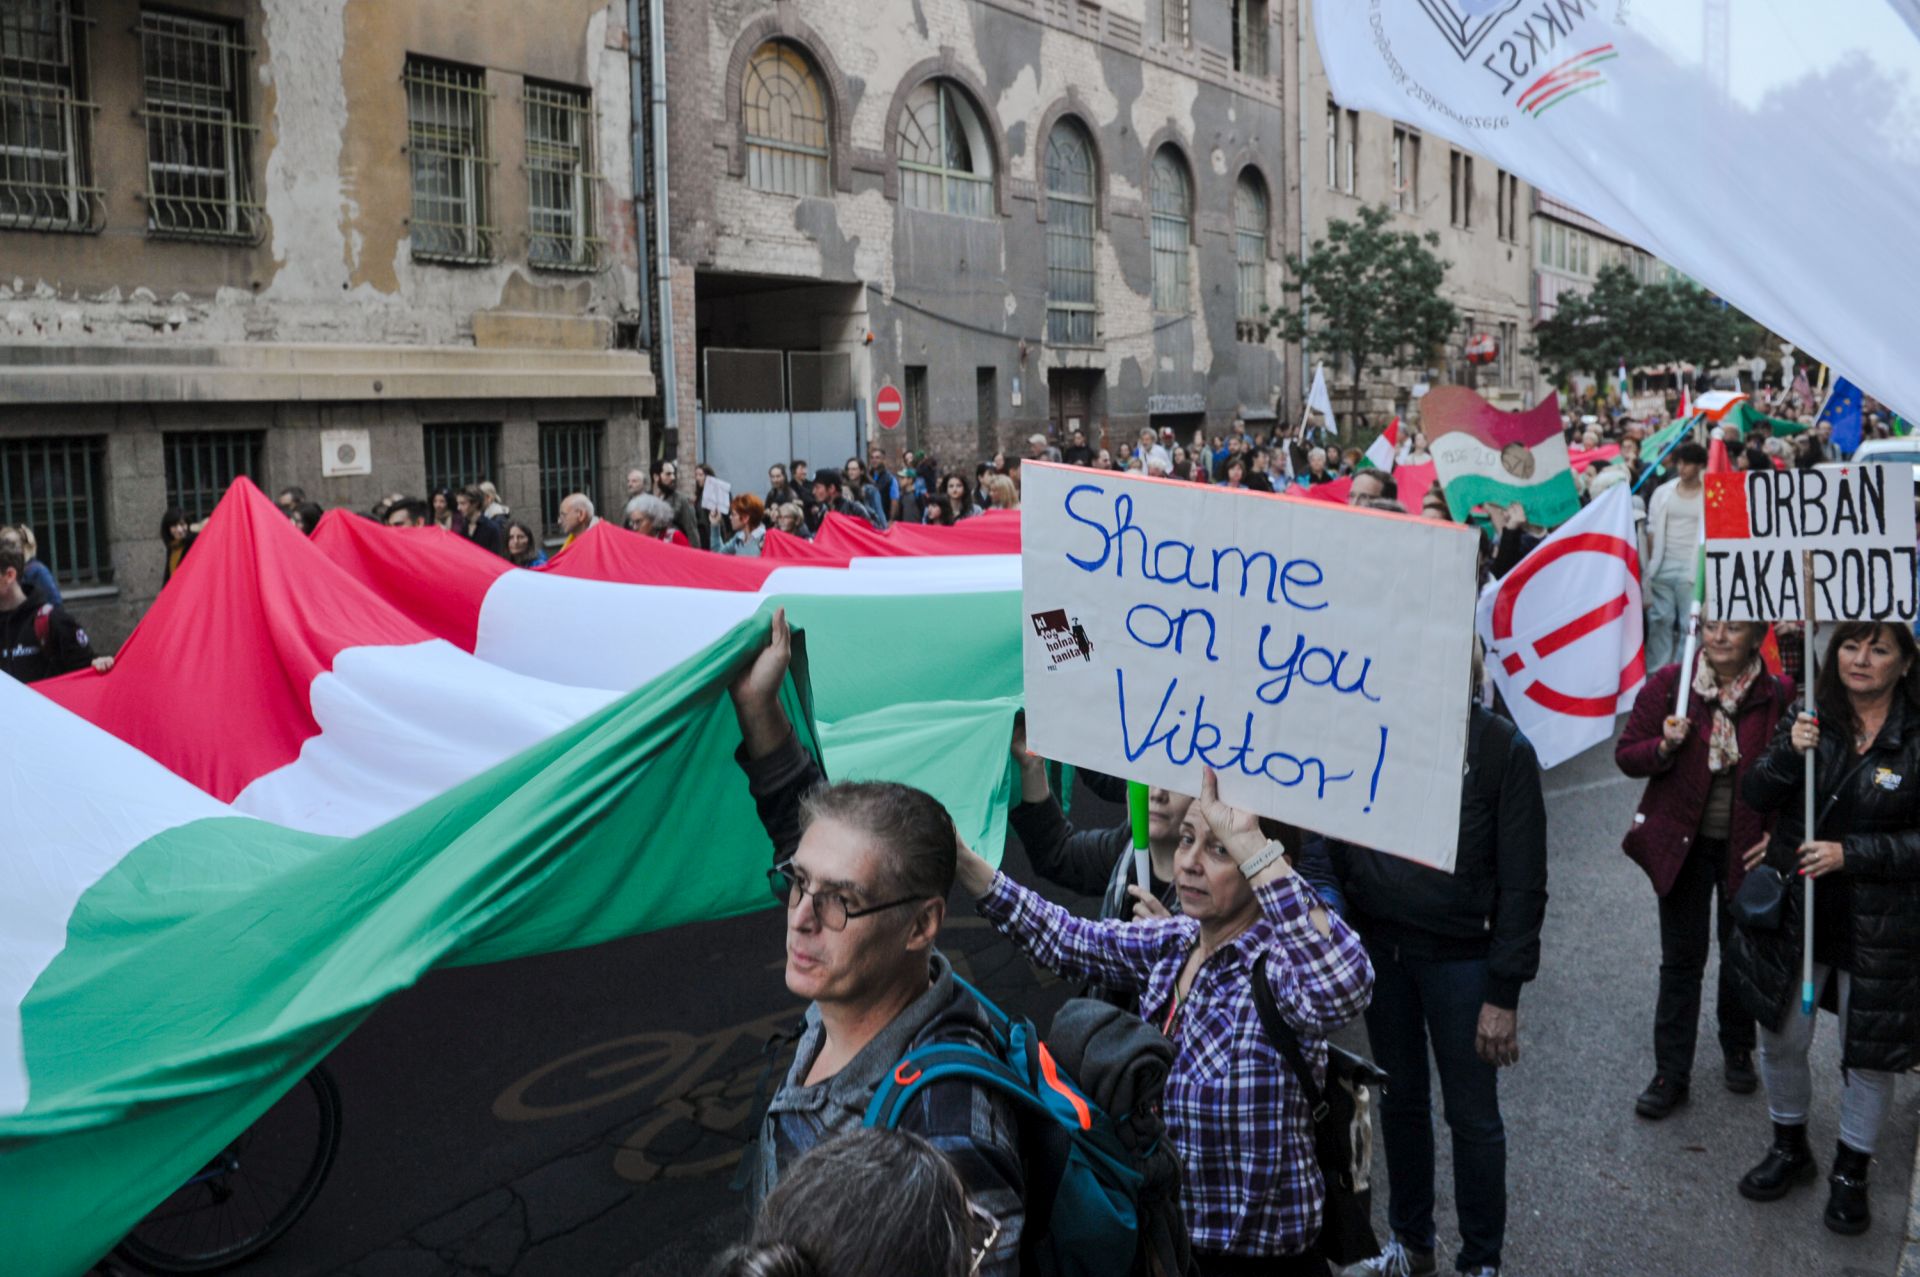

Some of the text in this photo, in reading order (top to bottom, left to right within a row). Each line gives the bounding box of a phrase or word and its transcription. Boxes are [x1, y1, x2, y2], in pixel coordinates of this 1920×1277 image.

[1065, 484, 1329, 611] Shame
[1706, 546, 1917, 621] TAKARODJ
[1126, 603, 1381, 705] on you
[1116, 668, 1389, 814] Viktor!
